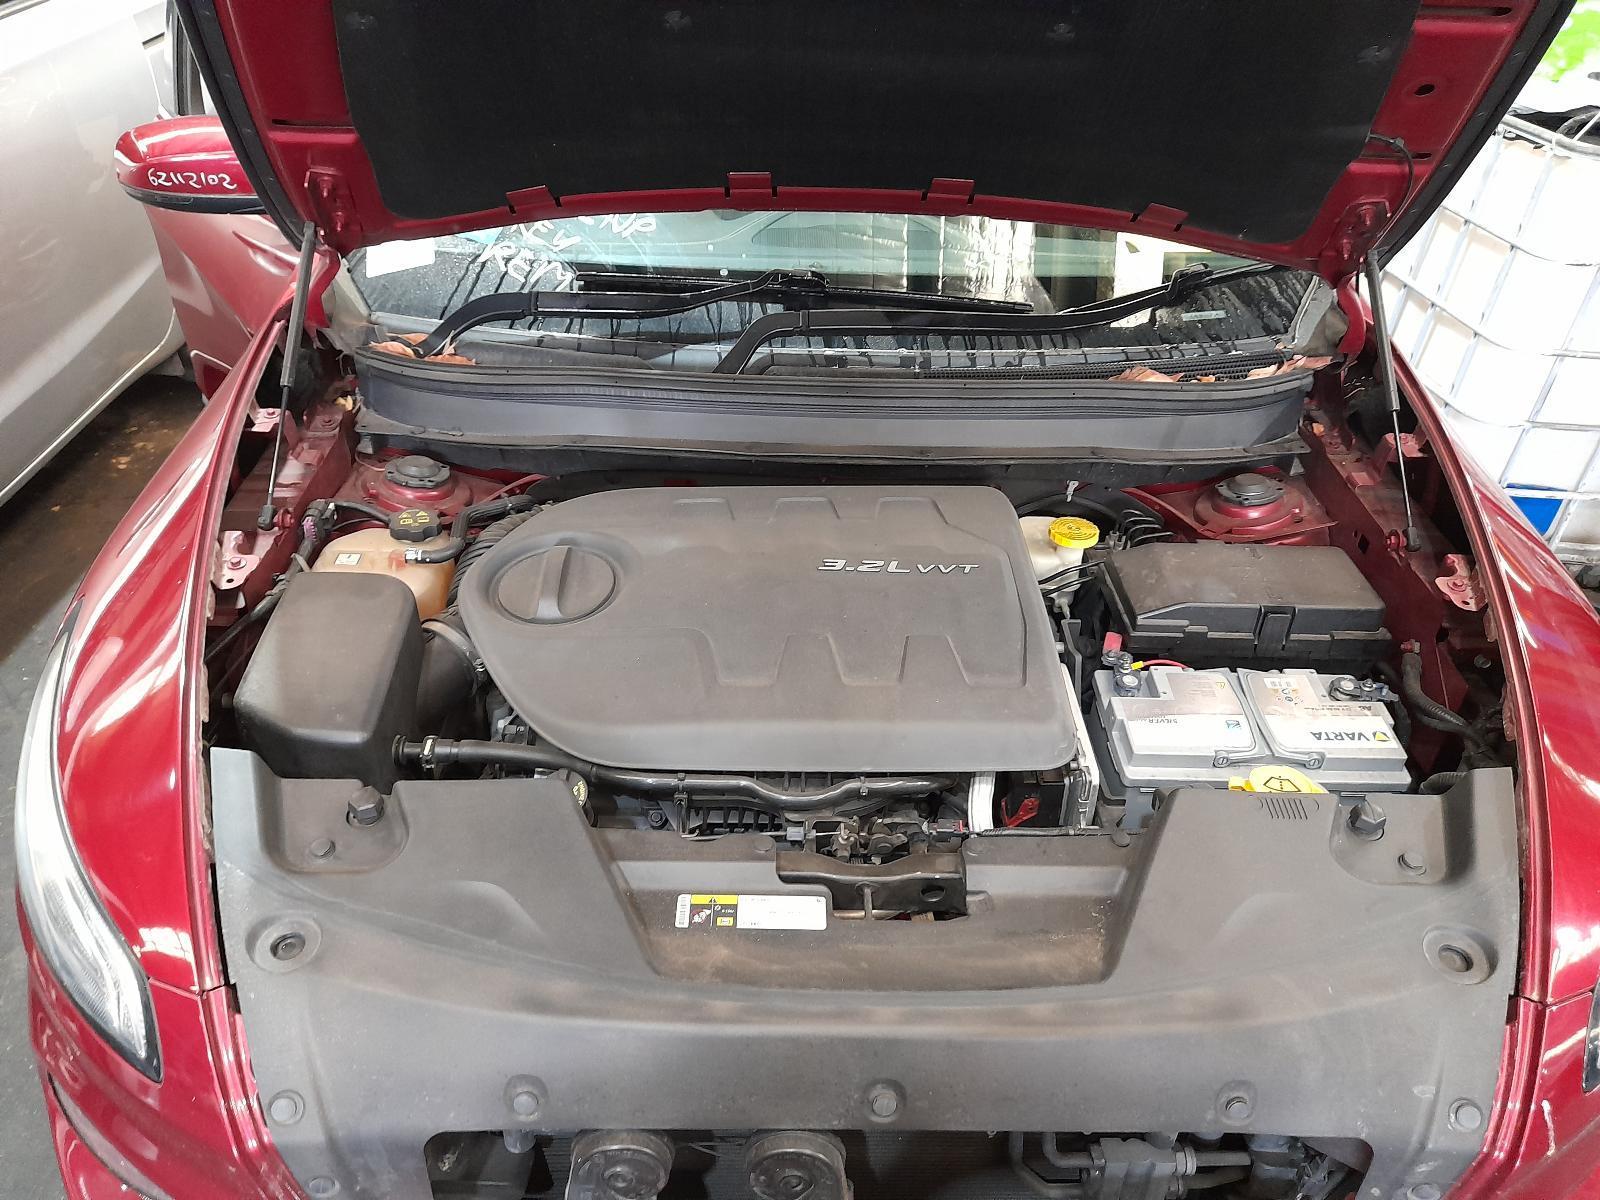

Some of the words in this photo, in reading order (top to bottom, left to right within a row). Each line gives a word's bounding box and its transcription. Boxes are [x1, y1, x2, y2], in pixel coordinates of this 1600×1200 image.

[817, 558, 911, 574] 3.2L
[916, 564, 980, 574] VVT
[1310, 731, 1370, 742] VARTA
